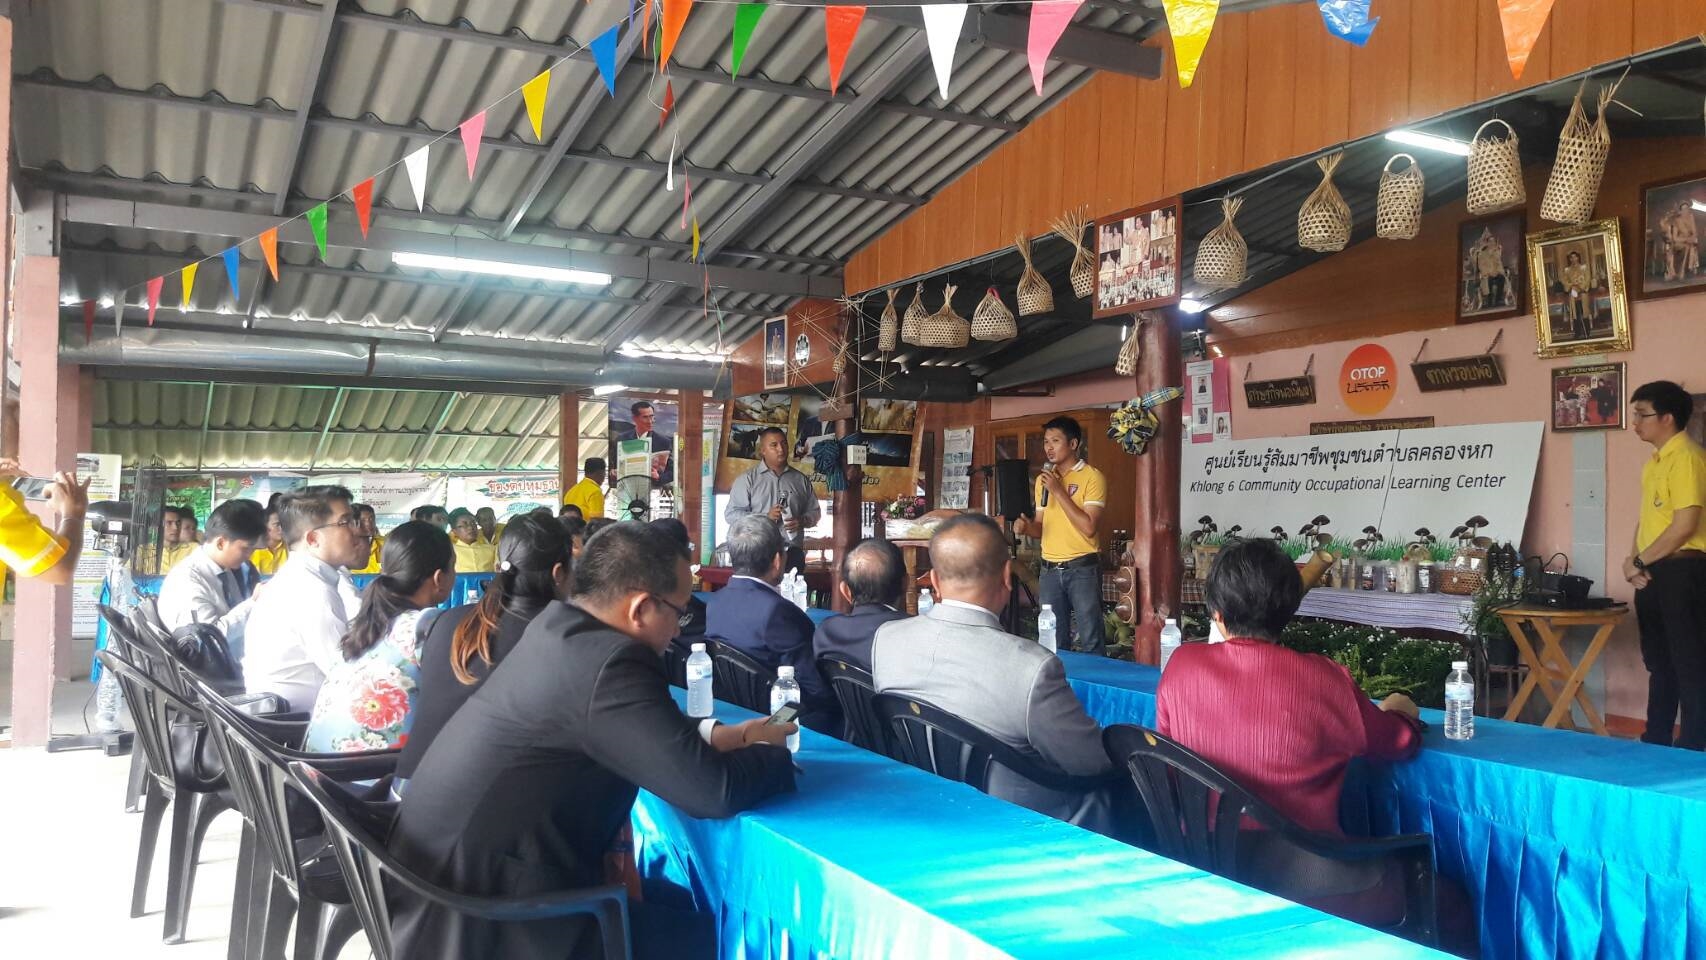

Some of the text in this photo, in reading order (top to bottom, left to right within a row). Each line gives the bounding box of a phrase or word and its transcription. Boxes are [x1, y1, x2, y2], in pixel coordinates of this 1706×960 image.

[1350, 366, 1386, 381] OTOP
[1204, 442, 1494, 476] ศูนย์เรียนรู้สัมมาชีพชุมชนตำบลคลองหก
[1190, 473, 1507, 495] Khlong 6 Community Occupational Learning Center
